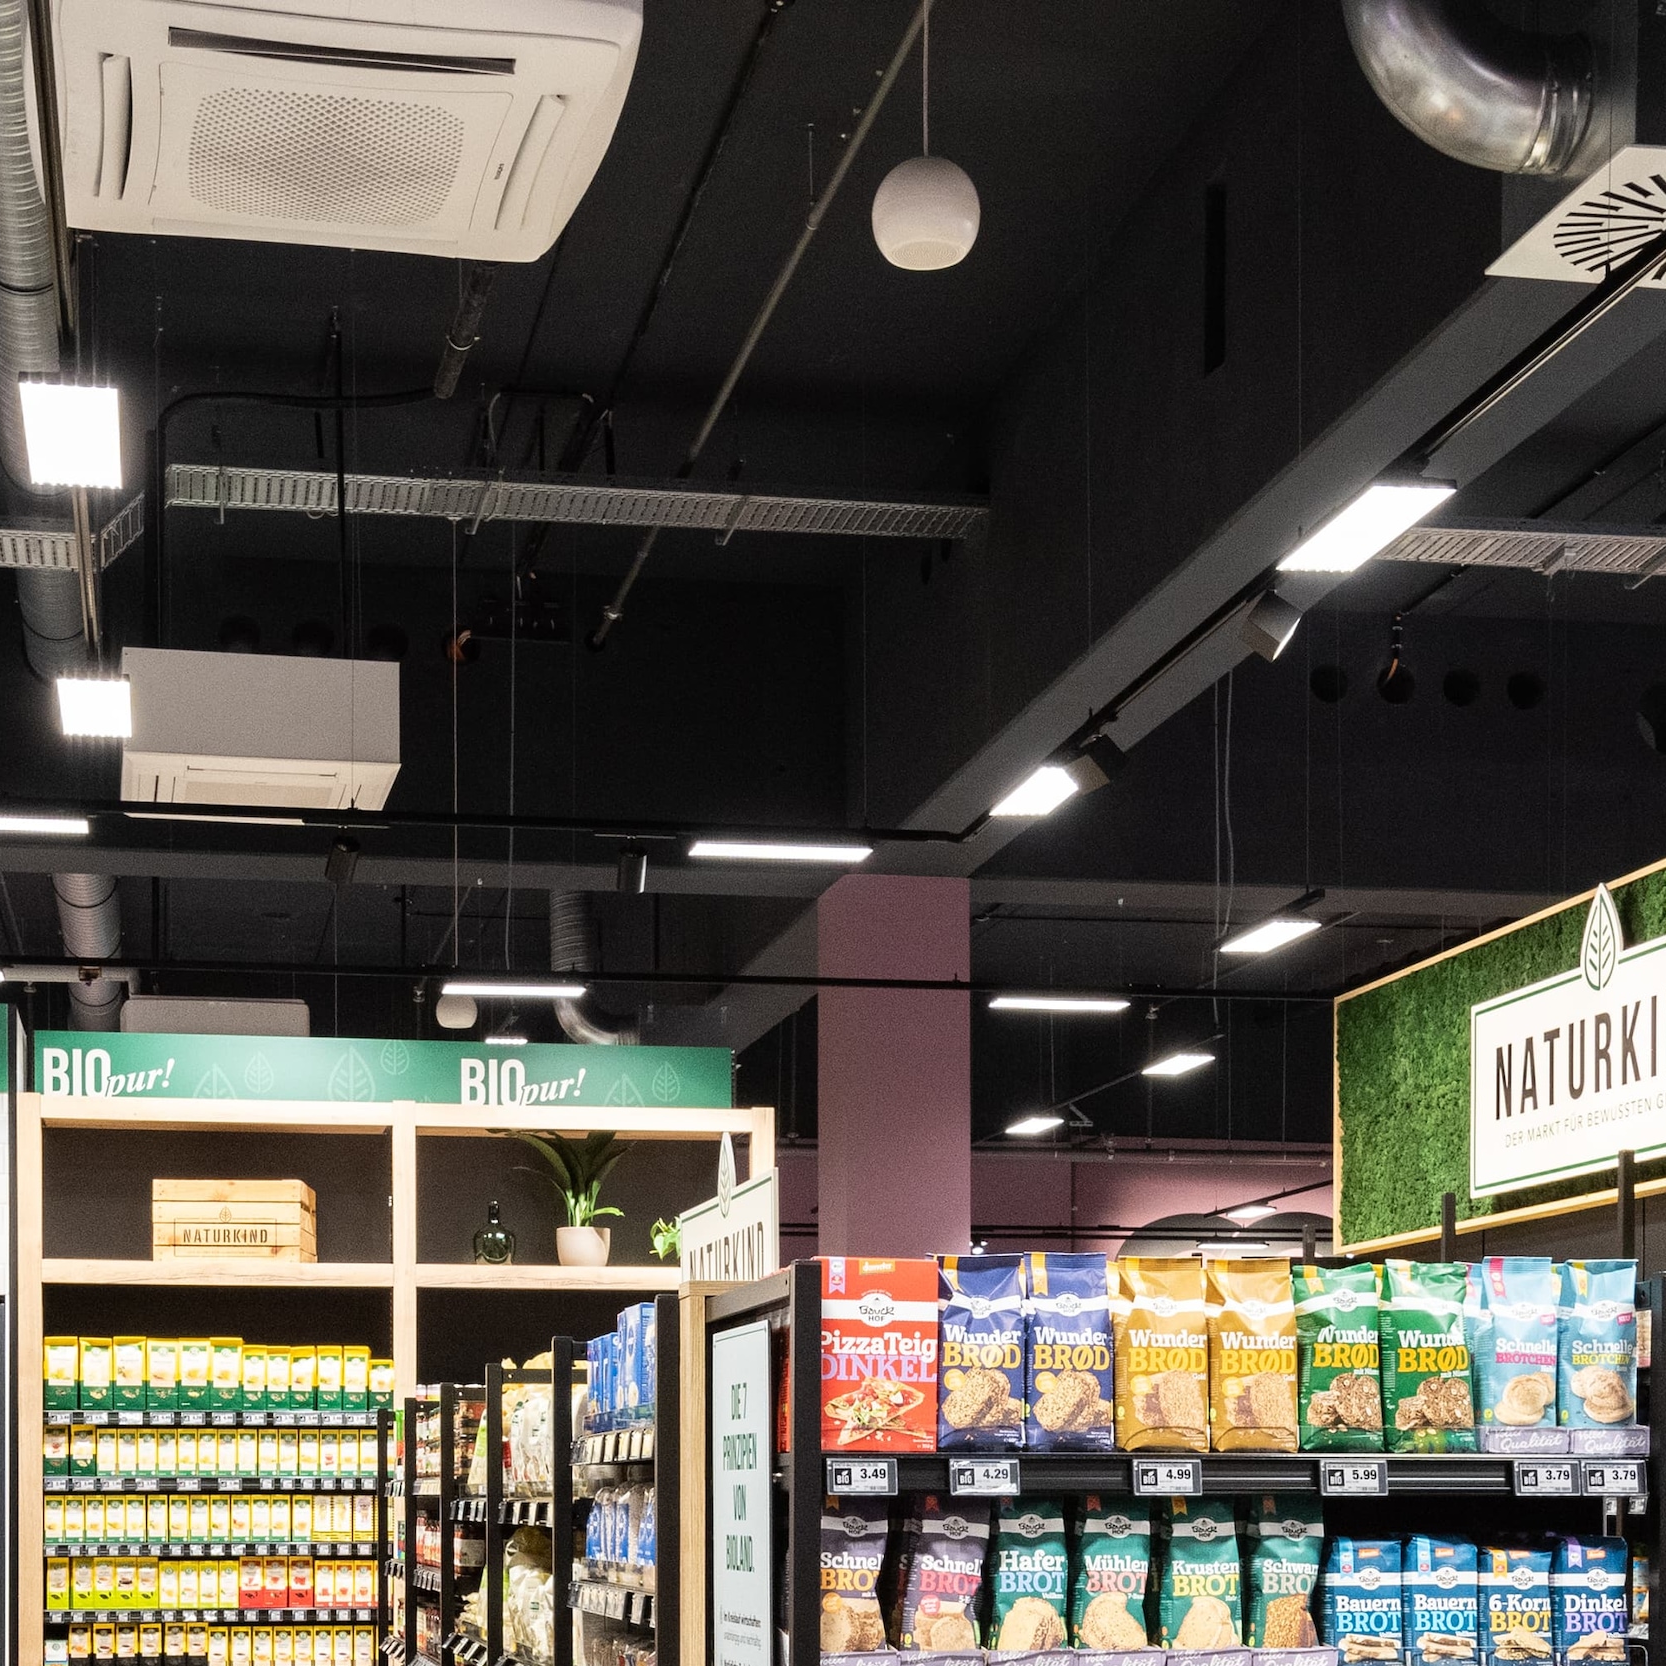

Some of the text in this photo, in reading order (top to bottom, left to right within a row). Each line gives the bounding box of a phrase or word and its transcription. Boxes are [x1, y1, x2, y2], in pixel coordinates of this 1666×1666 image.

[183, 1228, 268, 1244] NATURKIND
[943, 1324, 1021, 1346] Wunder
[1034, 1327, 1108, 1348] Wunder
[821, 1331, 936, 1363] PizzaTeig
[943, 1343, 1021, 1369] BRØD
[1495, 1337, 1557, 1355] Schnelle
[821, 1354, 936, 1382] DINKEL
[1034, 1345, 1110, 1371] BRØD
[1495, 1350, 1557, 1366] BRÖTCHEN
[1500, 1431, 1564, 1452] Qualität
[859, 1468, 887, 1480] 3.49
[982, 1469, 1009, 1481] 4.29
[1165, 1469, 1192, 1481] 4.99
[1352, 1470, 1378, 1481] 5.99
[1545, 1470, 1571, 1481] 3.79
[733, 1484, 746, 1521] VON
[999, 1550, 1066, 1572] Hafer
[1084, 1554, 1149, 1574] Mühlen
[1000, 1569, 1065, 1594] BROT
[1086, 1571, 1148, 1595] BROT
[1336, 1595, 1402, 1612] Bauern
[1489, 1593, 1552, 1612] 6-Korn
[1564, 1593, 1628, 1612] Dinkel
[1336, 1610, 1402, 1633] BROT
